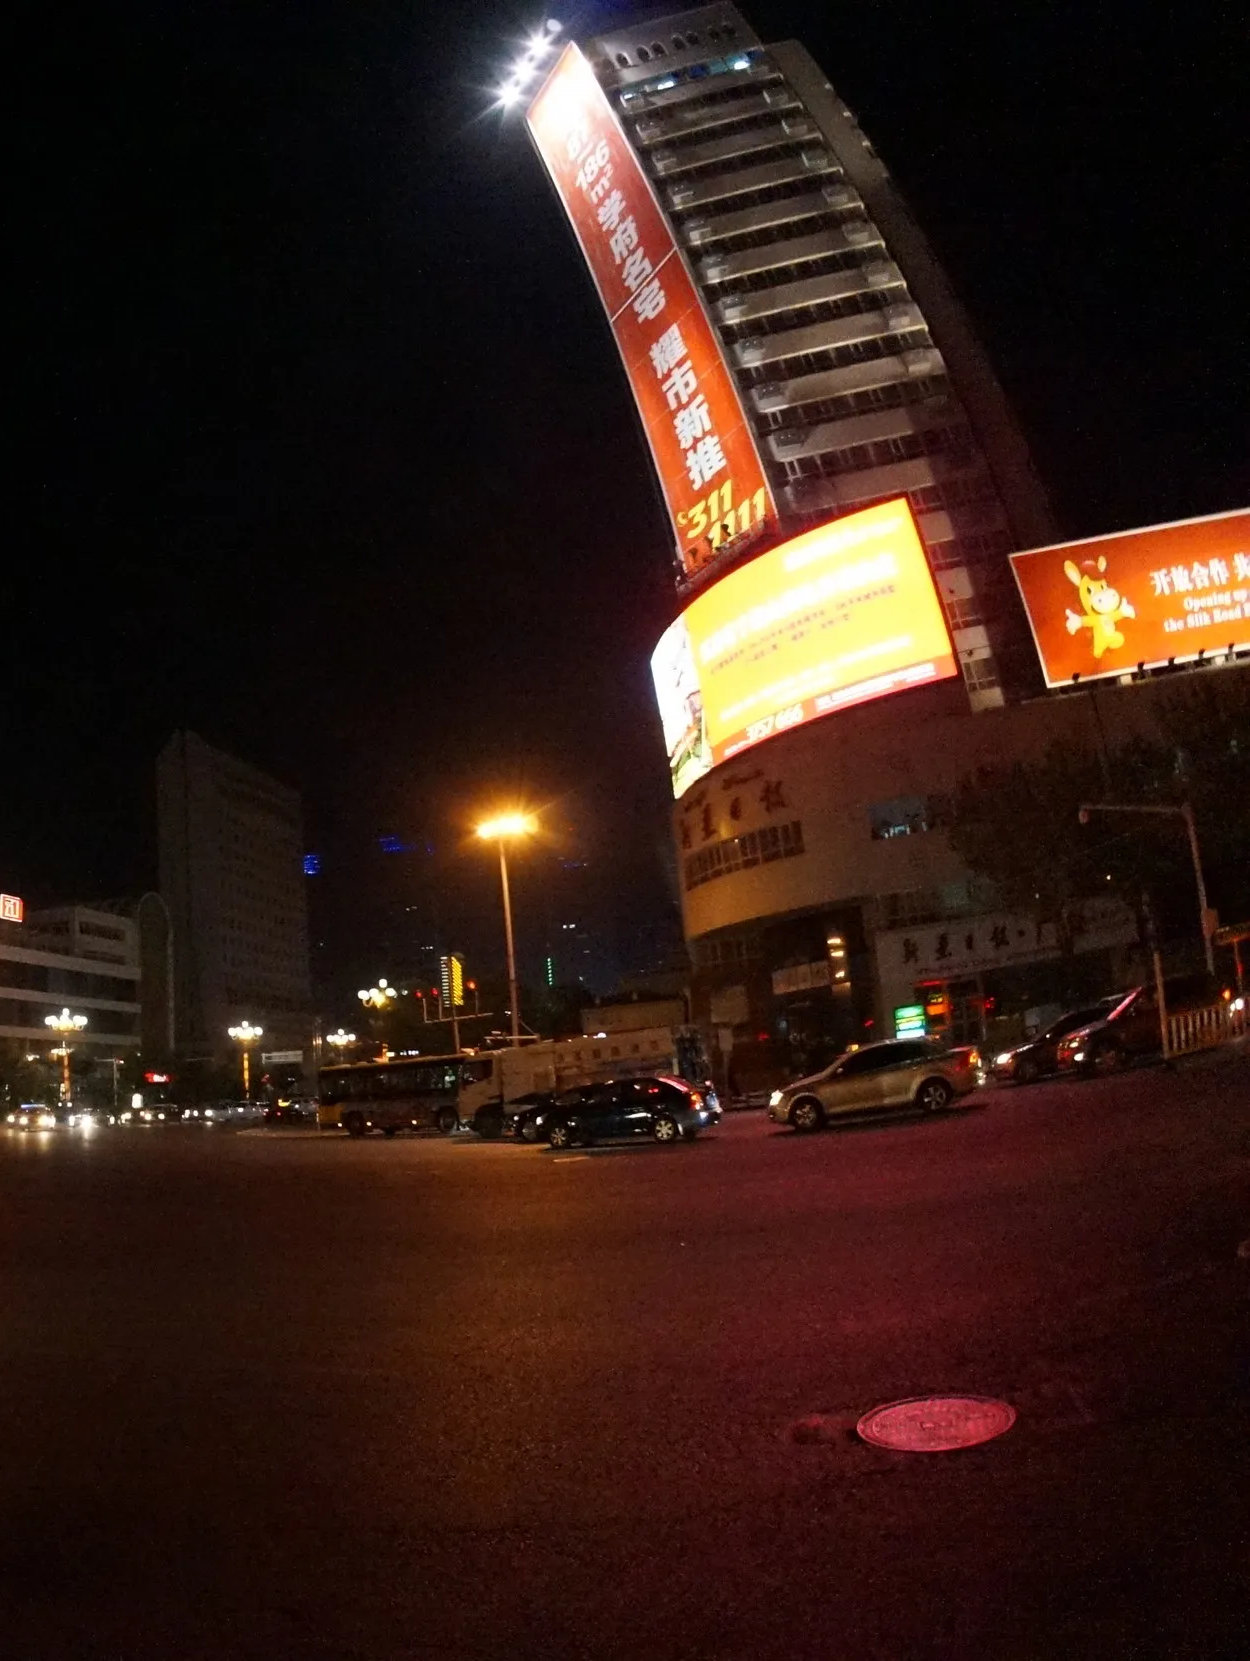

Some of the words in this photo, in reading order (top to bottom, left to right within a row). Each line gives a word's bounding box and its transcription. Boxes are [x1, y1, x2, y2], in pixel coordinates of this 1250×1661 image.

[1149, 557, 1230, 596] 开放合作
[1183, 591, 1231, 612] Opening
[1163, 617, 1184, 632] the
[1187, 611, 1211, 628] Silk
[1213, 604, 1241, 623] Road
